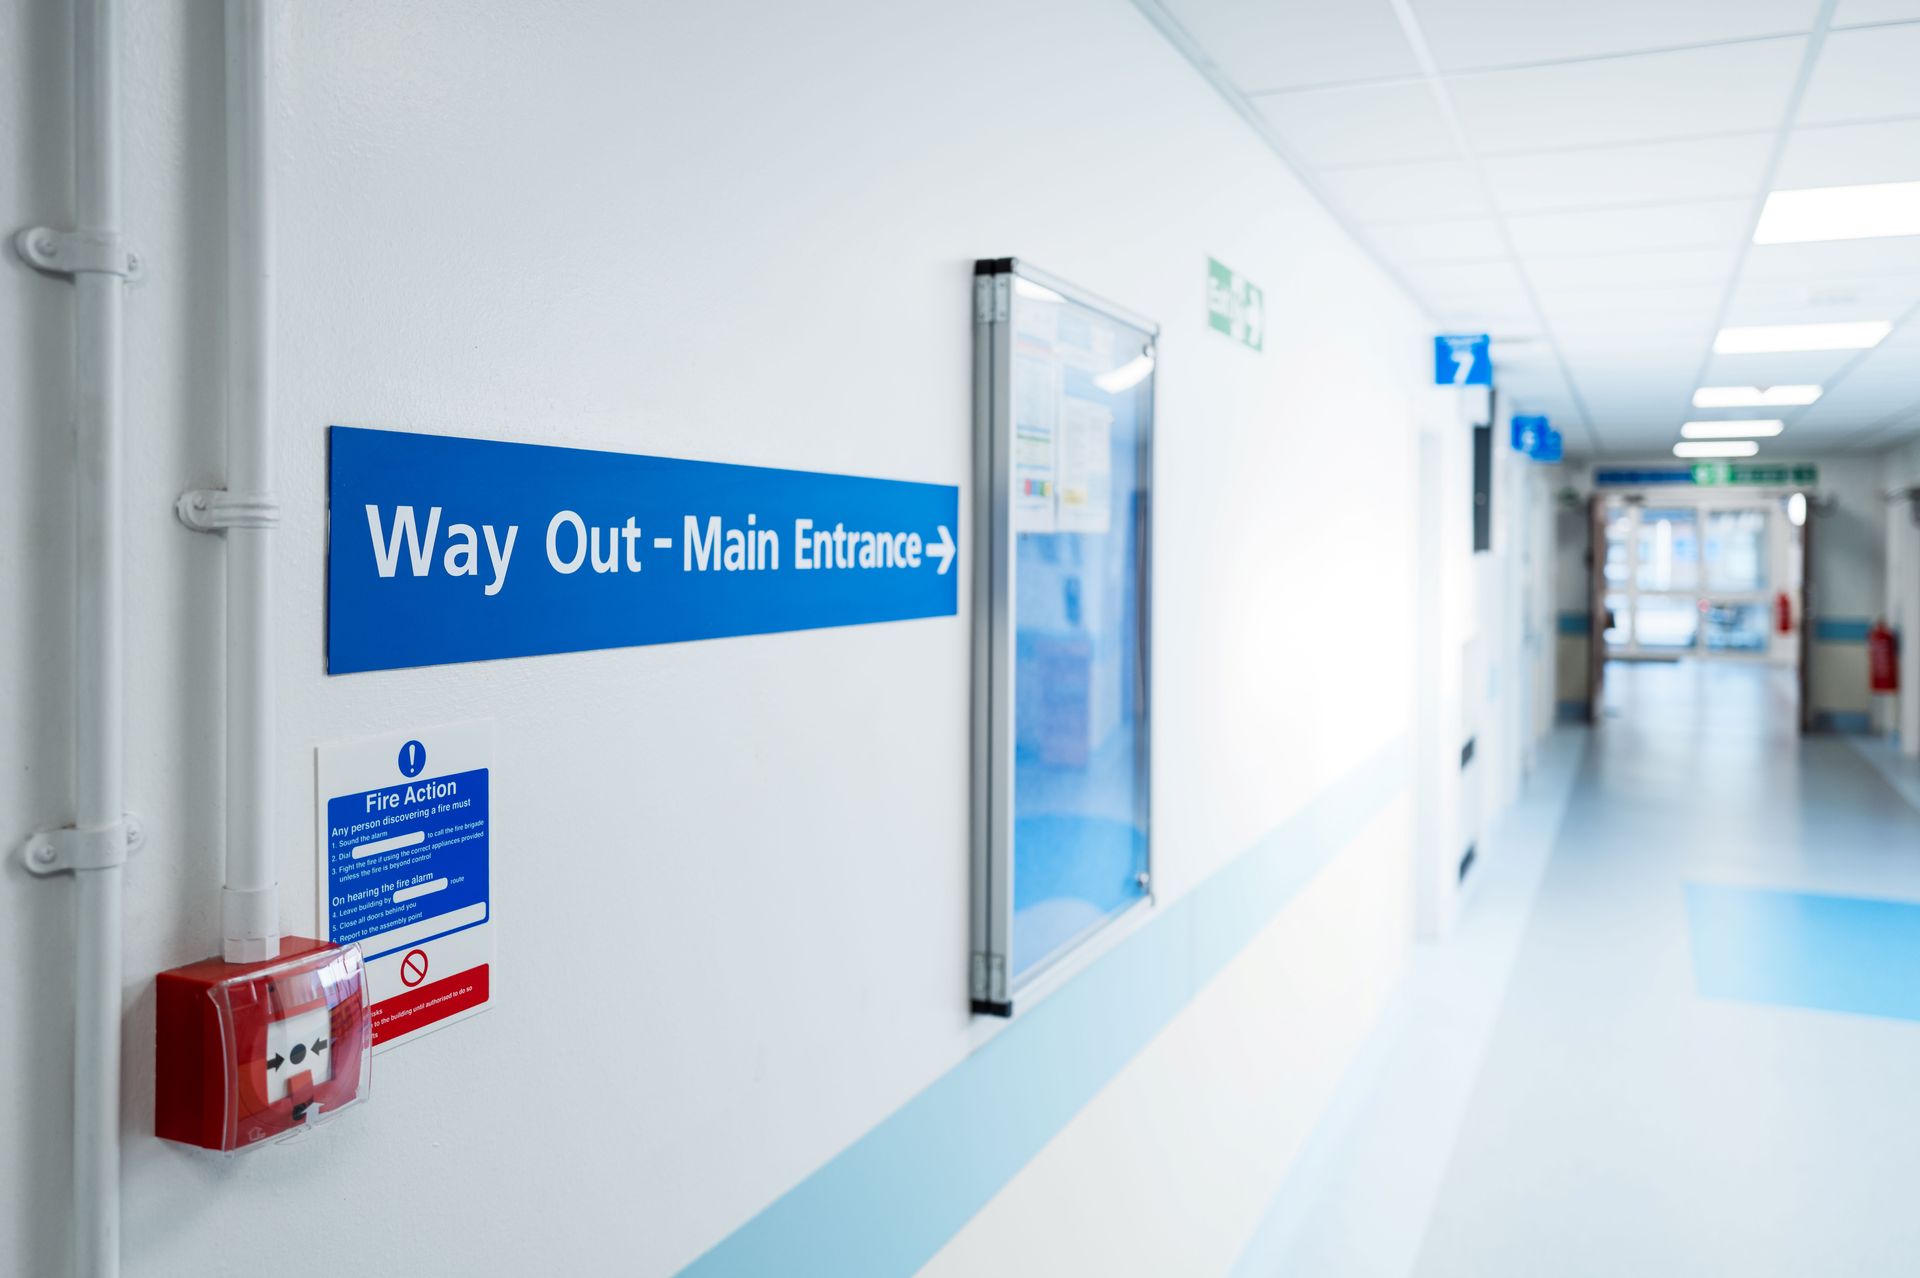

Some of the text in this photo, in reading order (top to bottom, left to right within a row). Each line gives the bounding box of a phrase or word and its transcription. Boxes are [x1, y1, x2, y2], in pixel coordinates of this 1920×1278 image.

[1450, 349, 1475, 384] 7
[365, 504, 922, 596] Way Out - Main Entrance
[366, 781, 457, 813] Fire Action
[332, 827, 348, 837] Any
[351, 819, 380, 835] person
[382, 808, 430, 826] discovering
[438, 803, 450, 813] fire
[452, 798, 471, 810] must
[338, 837, 359, 848] Sound
[360, 834, 370, 842] the
[371, 830, 388, 840] alarm
[338, 852, 350, 860] Dial
[434, 829, 444, 837] call
[464, 820, 484, 830] brigade
[339, 864, 355, 874] Fight
[366, 856, 376, 866] fire
[378, 856, 382, 864] if
[383, 851, 400, 862] using
[400, 848, 410, 856] the
[410, 844, 430, 855] correct
[431, 838, 460, 850] appliances
[461, 831, 484, 843] provided
[339, 872, 360, 882] unless
[390, 858, 410, 870] beyond
[412, 852, 432, 864] control
[332, 872, 434, 906] On hearing the fire alarm
[339, 907, 358, 917] Leave
[358, 899, 382, 911] building
[450, 876, 464, 884] route
[339, 920, 357, 930] Close
[366, 911, 384, 922] doors
[385, 904, 405, 916] behind
[406, 902, 416, 911] you
[339, 931, 360, 942] Report
[380, 917, 406, 930] assembly
[407, 912, 422, 923] point
[390, 1008, 412, 1020] building
[413, 1003, 425, 1012] until
[426, 992, 452, 1008] authorised
